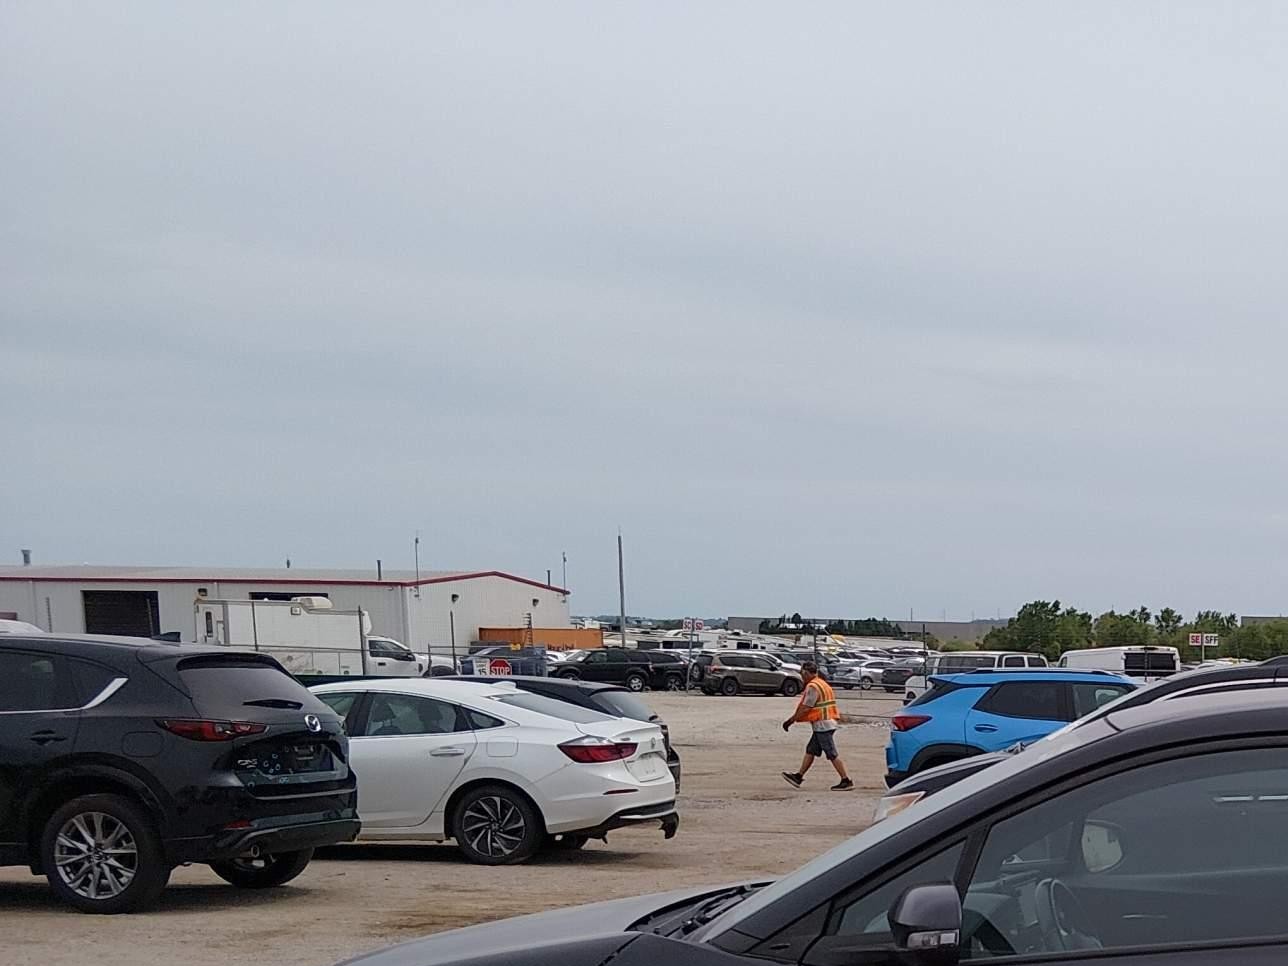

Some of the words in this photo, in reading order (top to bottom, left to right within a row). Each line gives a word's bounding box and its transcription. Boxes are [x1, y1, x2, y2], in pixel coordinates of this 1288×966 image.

[1190, 635, 1200, 644] SE
[1204, 635, 1217, 645] SFF
[491, 666, 511, 676] STOP
